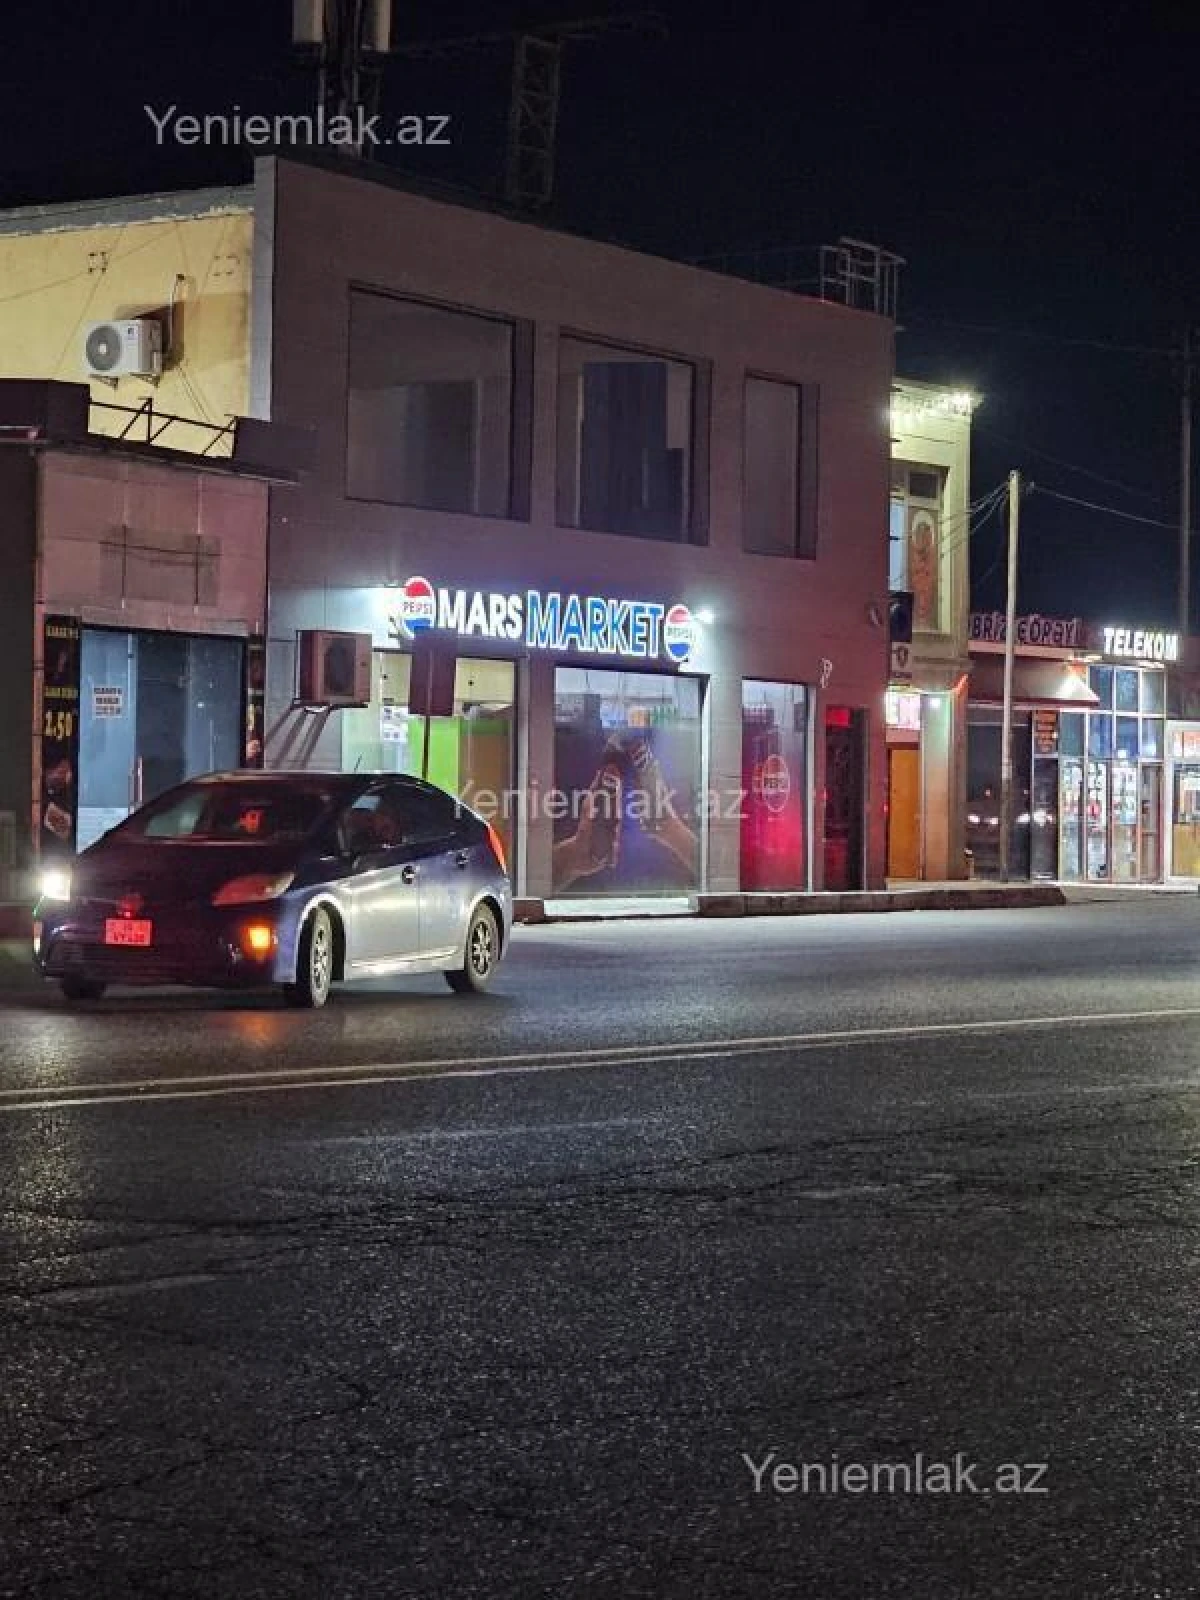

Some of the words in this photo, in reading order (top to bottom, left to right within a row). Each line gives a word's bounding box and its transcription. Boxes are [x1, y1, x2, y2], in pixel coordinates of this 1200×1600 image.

[403, 601, 433, 614] PEPSI
[437, 587, 523, 639] MARS
[526, 589, 665, 659] MARKET
[1103, 627, 1178, 661] TELEKOM
